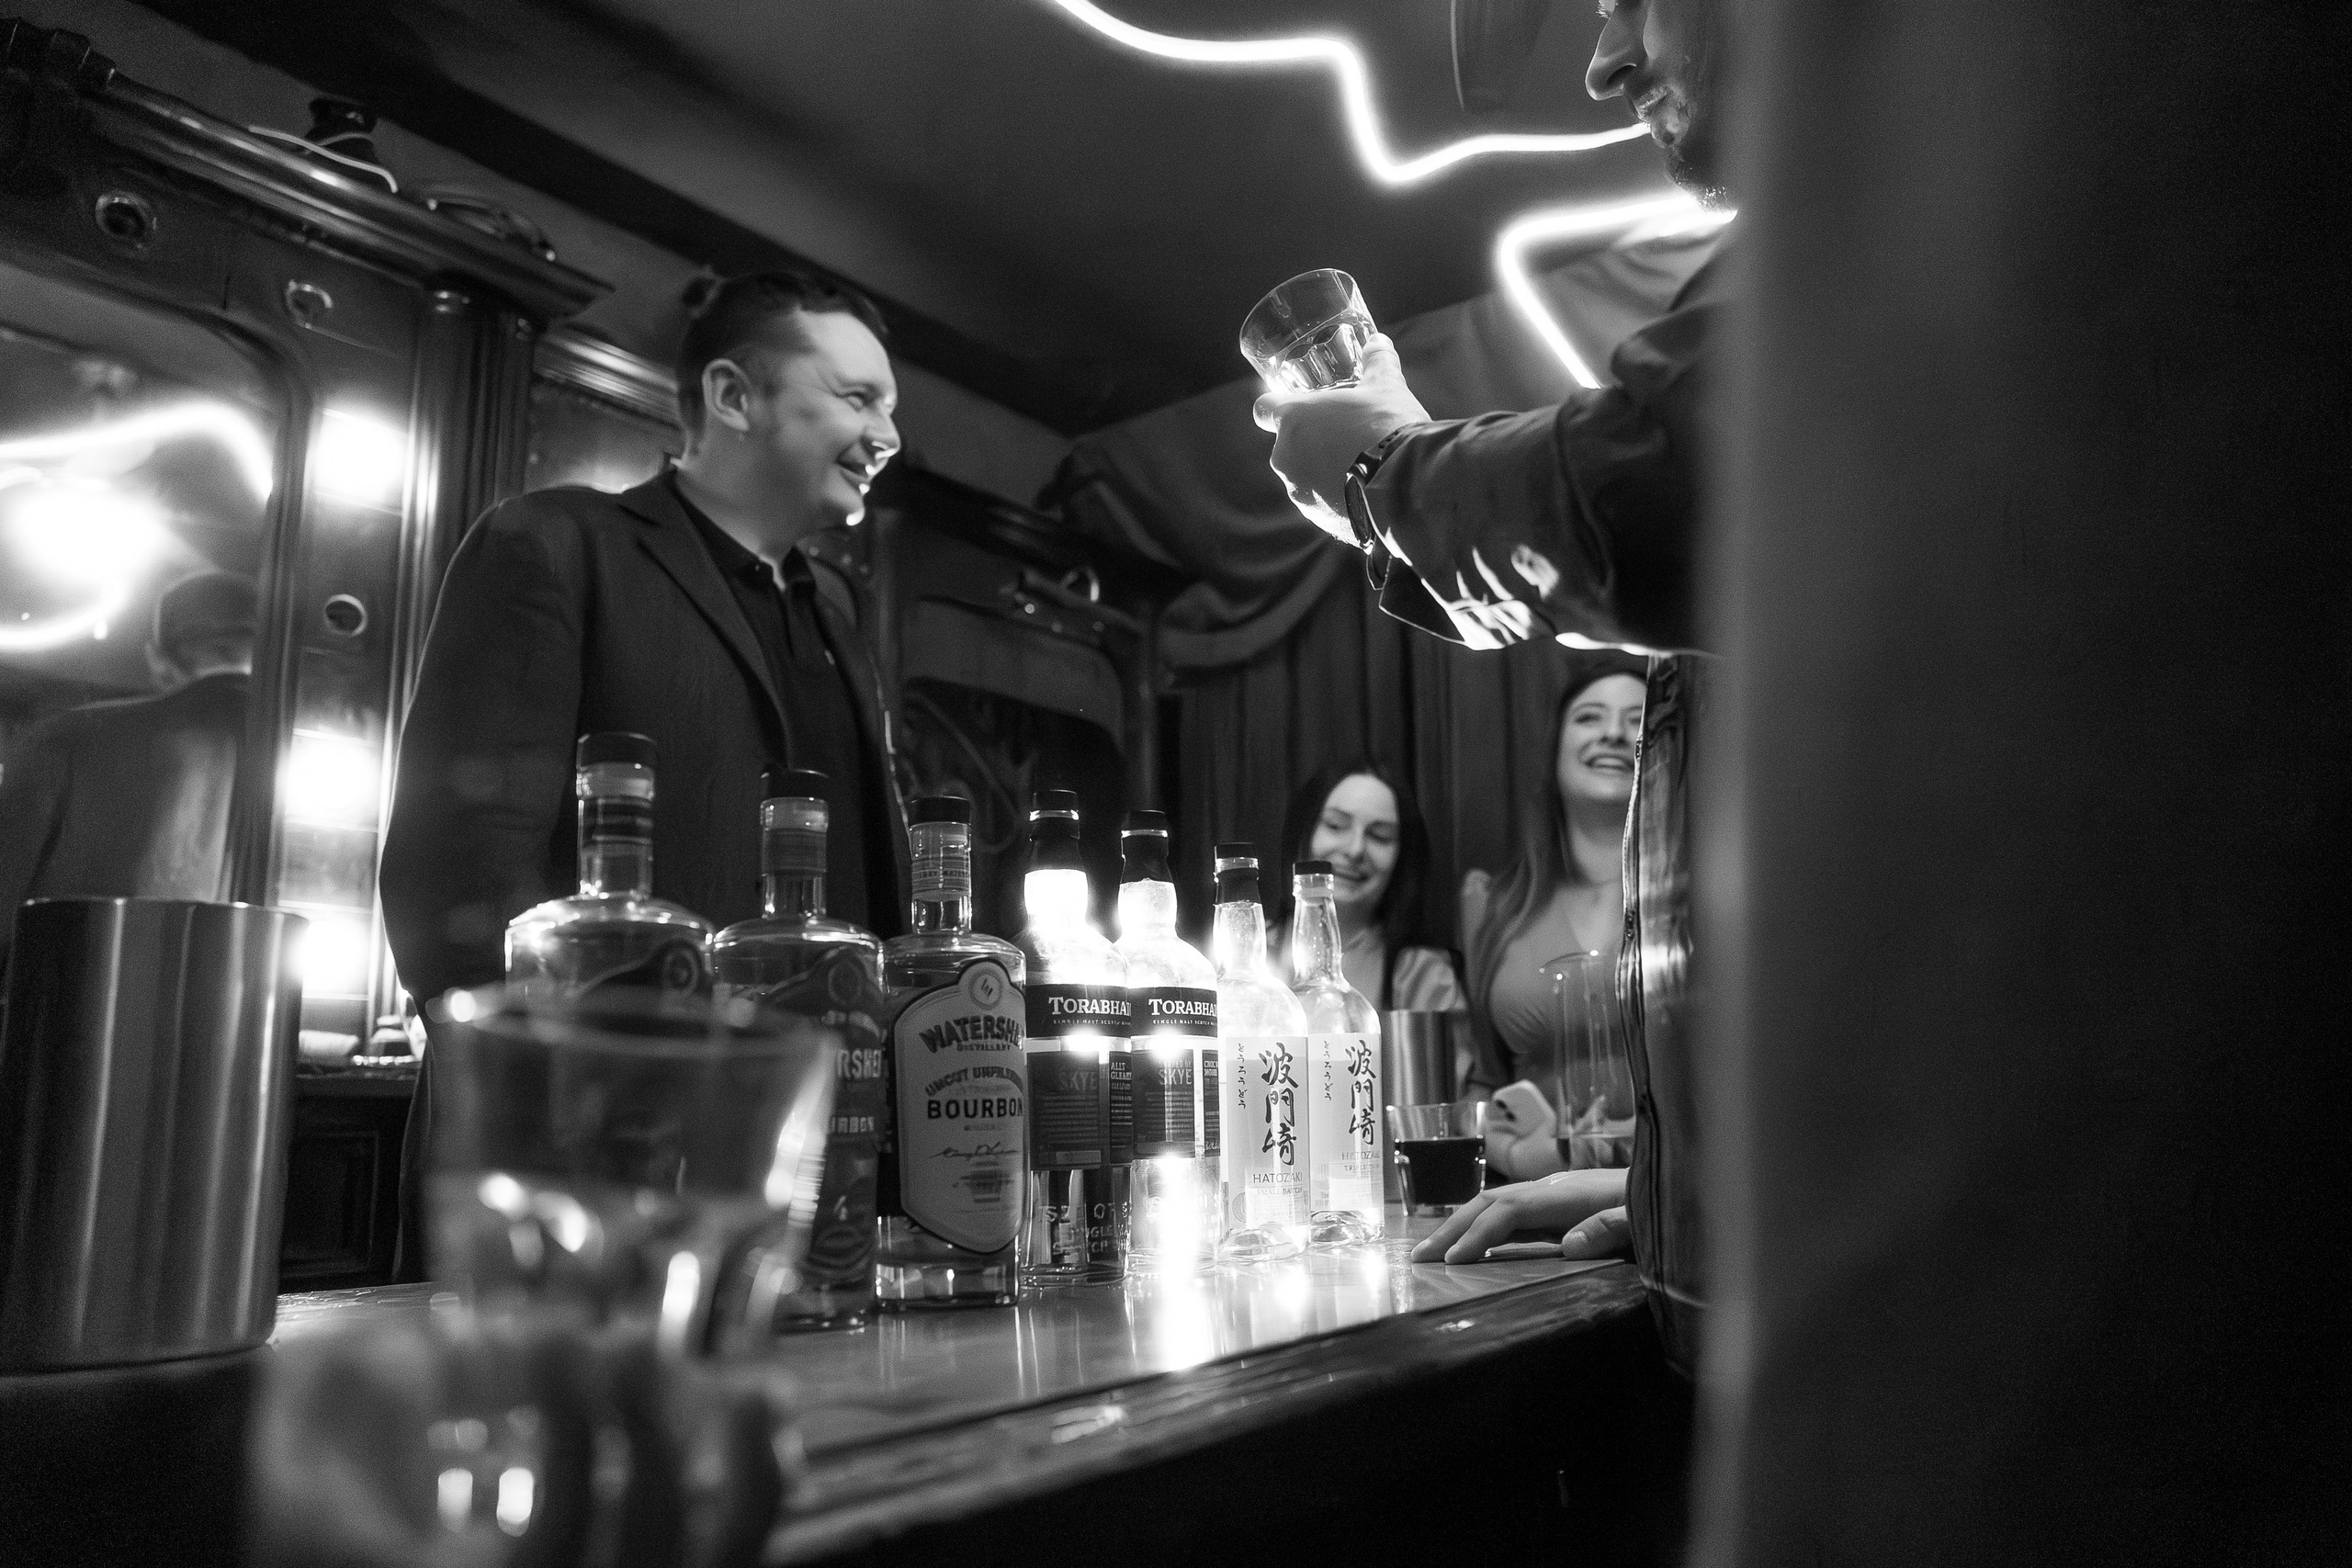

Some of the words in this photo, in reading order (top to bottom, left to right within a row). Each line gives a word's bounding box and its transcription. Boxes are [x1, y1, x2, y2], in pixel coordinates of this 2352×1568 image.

[1048, 997, 1131, 1017] TORABHAI
[1148, 998, 1216, 1018] TORABHAI
[1159, 1068, 1193, 1085] SKYE
[927, 1098, 1023, 1120] BOURBON
[1253, 1171, 1303, 1184] HATOZAKI
